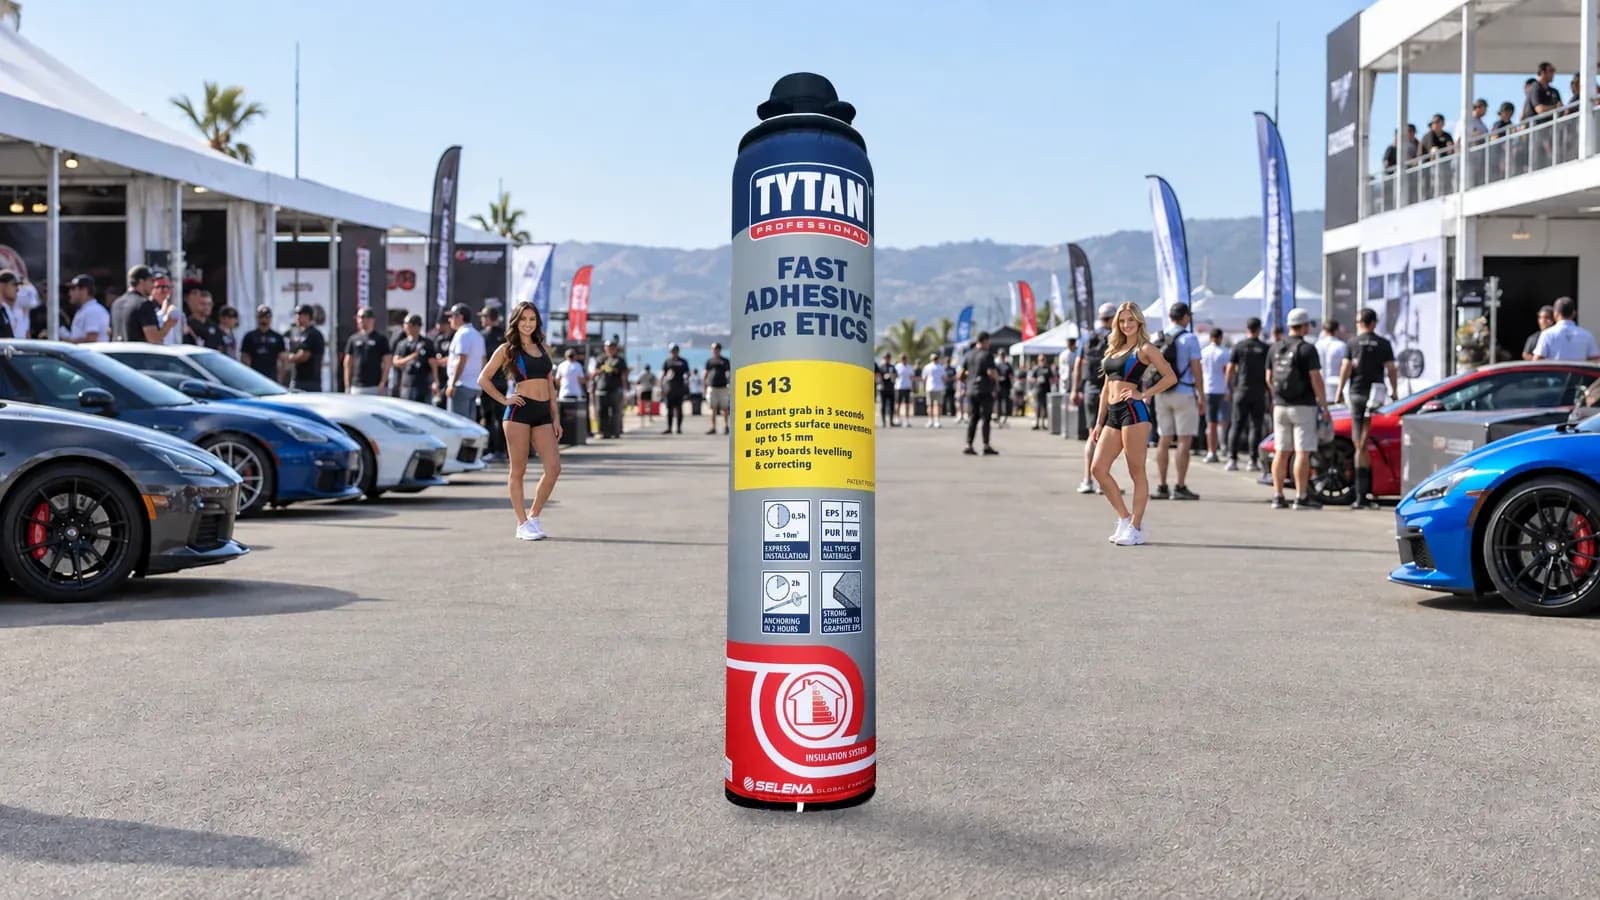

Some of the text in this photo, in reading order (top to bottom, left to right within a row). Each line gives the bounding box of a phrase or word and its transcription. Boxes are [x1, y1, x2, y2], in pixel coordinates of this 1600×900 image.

[756, 171, 864, 223] TYTAN
[756, 221, 865, 241] PROFESSIONAL
[778, 256, 848, 282] FAST
[744, 284, 872, 320] ADHESIVE
[751, 312, 868, 344] FOR ETICS
[745, 376, 792, 397] IS 13
[755, 406, 864, 420] Instant grab in 3 seconds
[755, 420, 791, 431] Corrects
[794, 419, 830, 429] surface
[755, 433, 813, 445] up to 15 mm
[755, 446, 853, 459] Easy boards levelling
[755, 460, 812, 470] & correcting
[825, 509, 839, 517] EPS
[846, 510, 858, 518] XPS
[824, 528, 840, 537] PUR
[845, 529, 858, 537] MW
[823, 617, 852, 625] ADHESION
[823, 624, 851, 633] GRAPHITE
[805, 751, 848, 762] INSULATION
[755, 781, 814, 794] SELENA
[816, 786, 845, 794] GLOBAL
